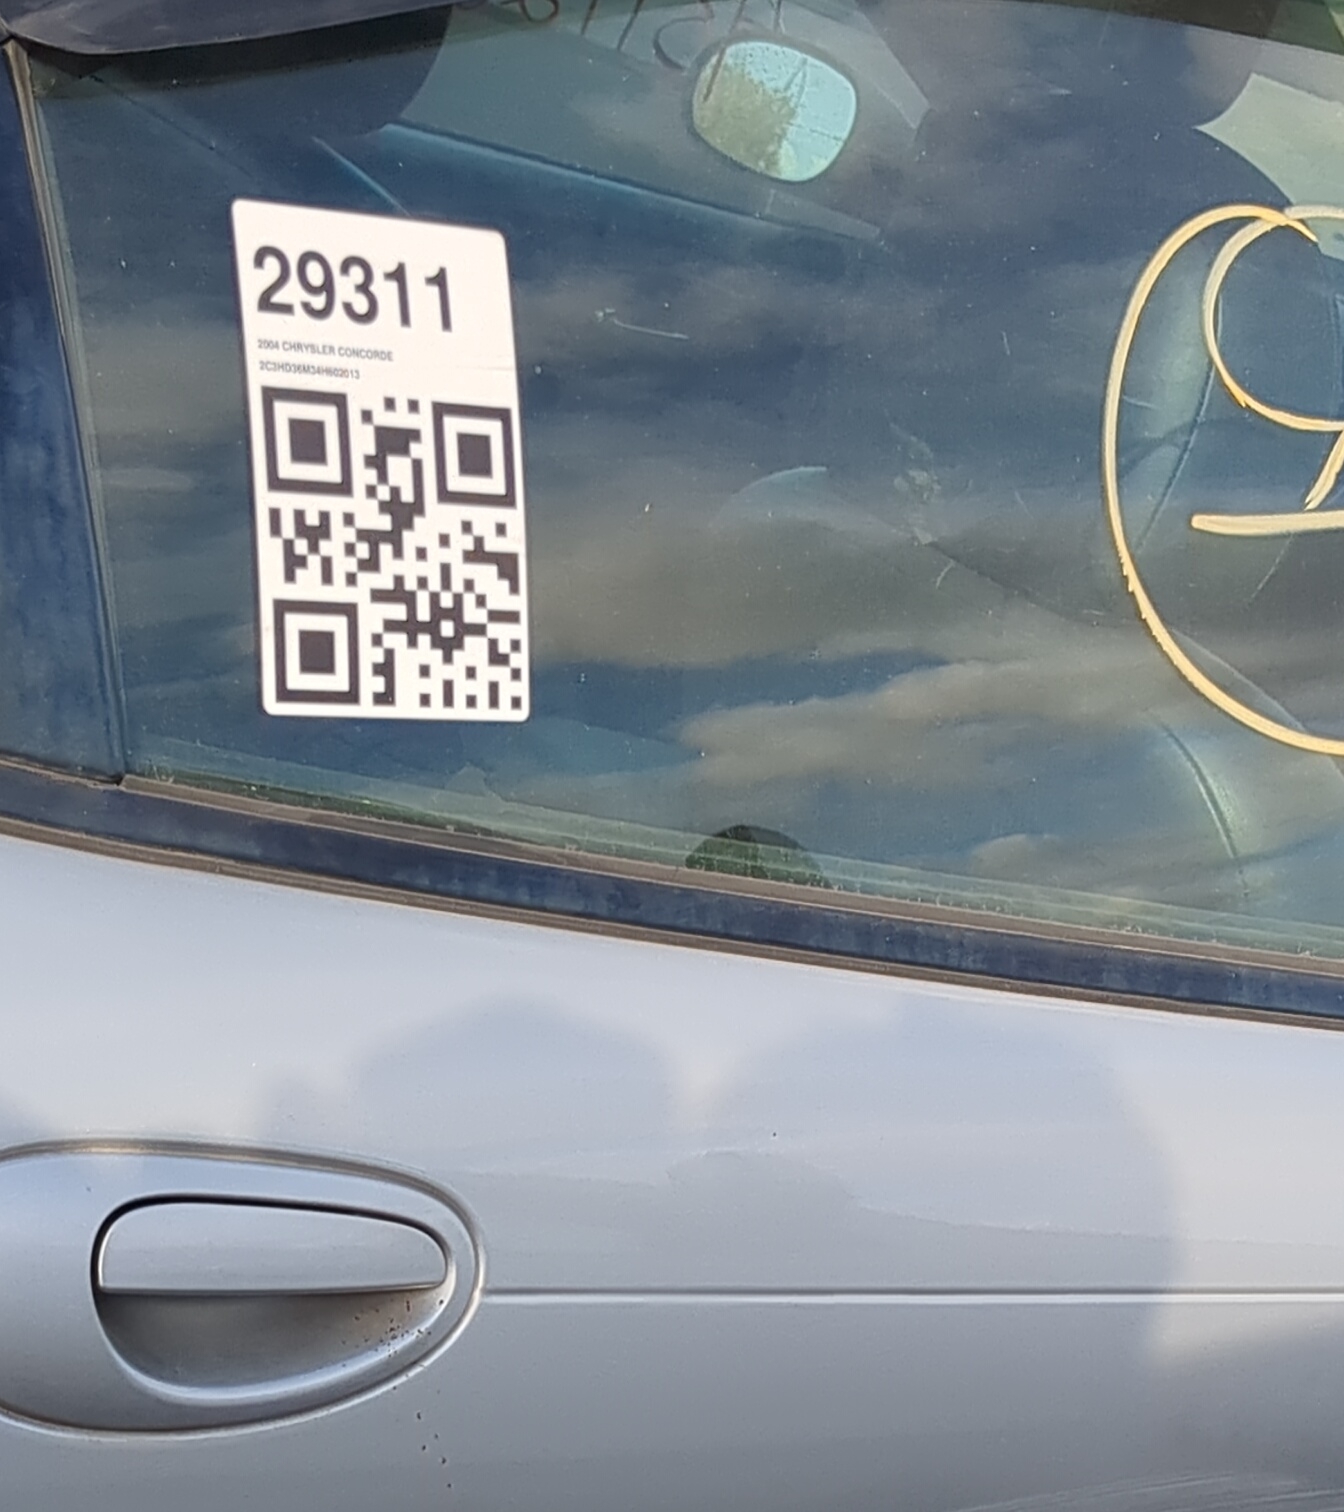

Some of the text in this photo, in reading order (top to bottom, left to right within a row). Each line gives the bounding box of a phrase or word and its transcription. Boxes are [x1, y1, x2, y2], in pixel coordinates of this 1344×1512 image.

[253, 245, 452, 333] 29311
[257, 339, 394, 362] 2004 CHRYSLER CONCORDE
